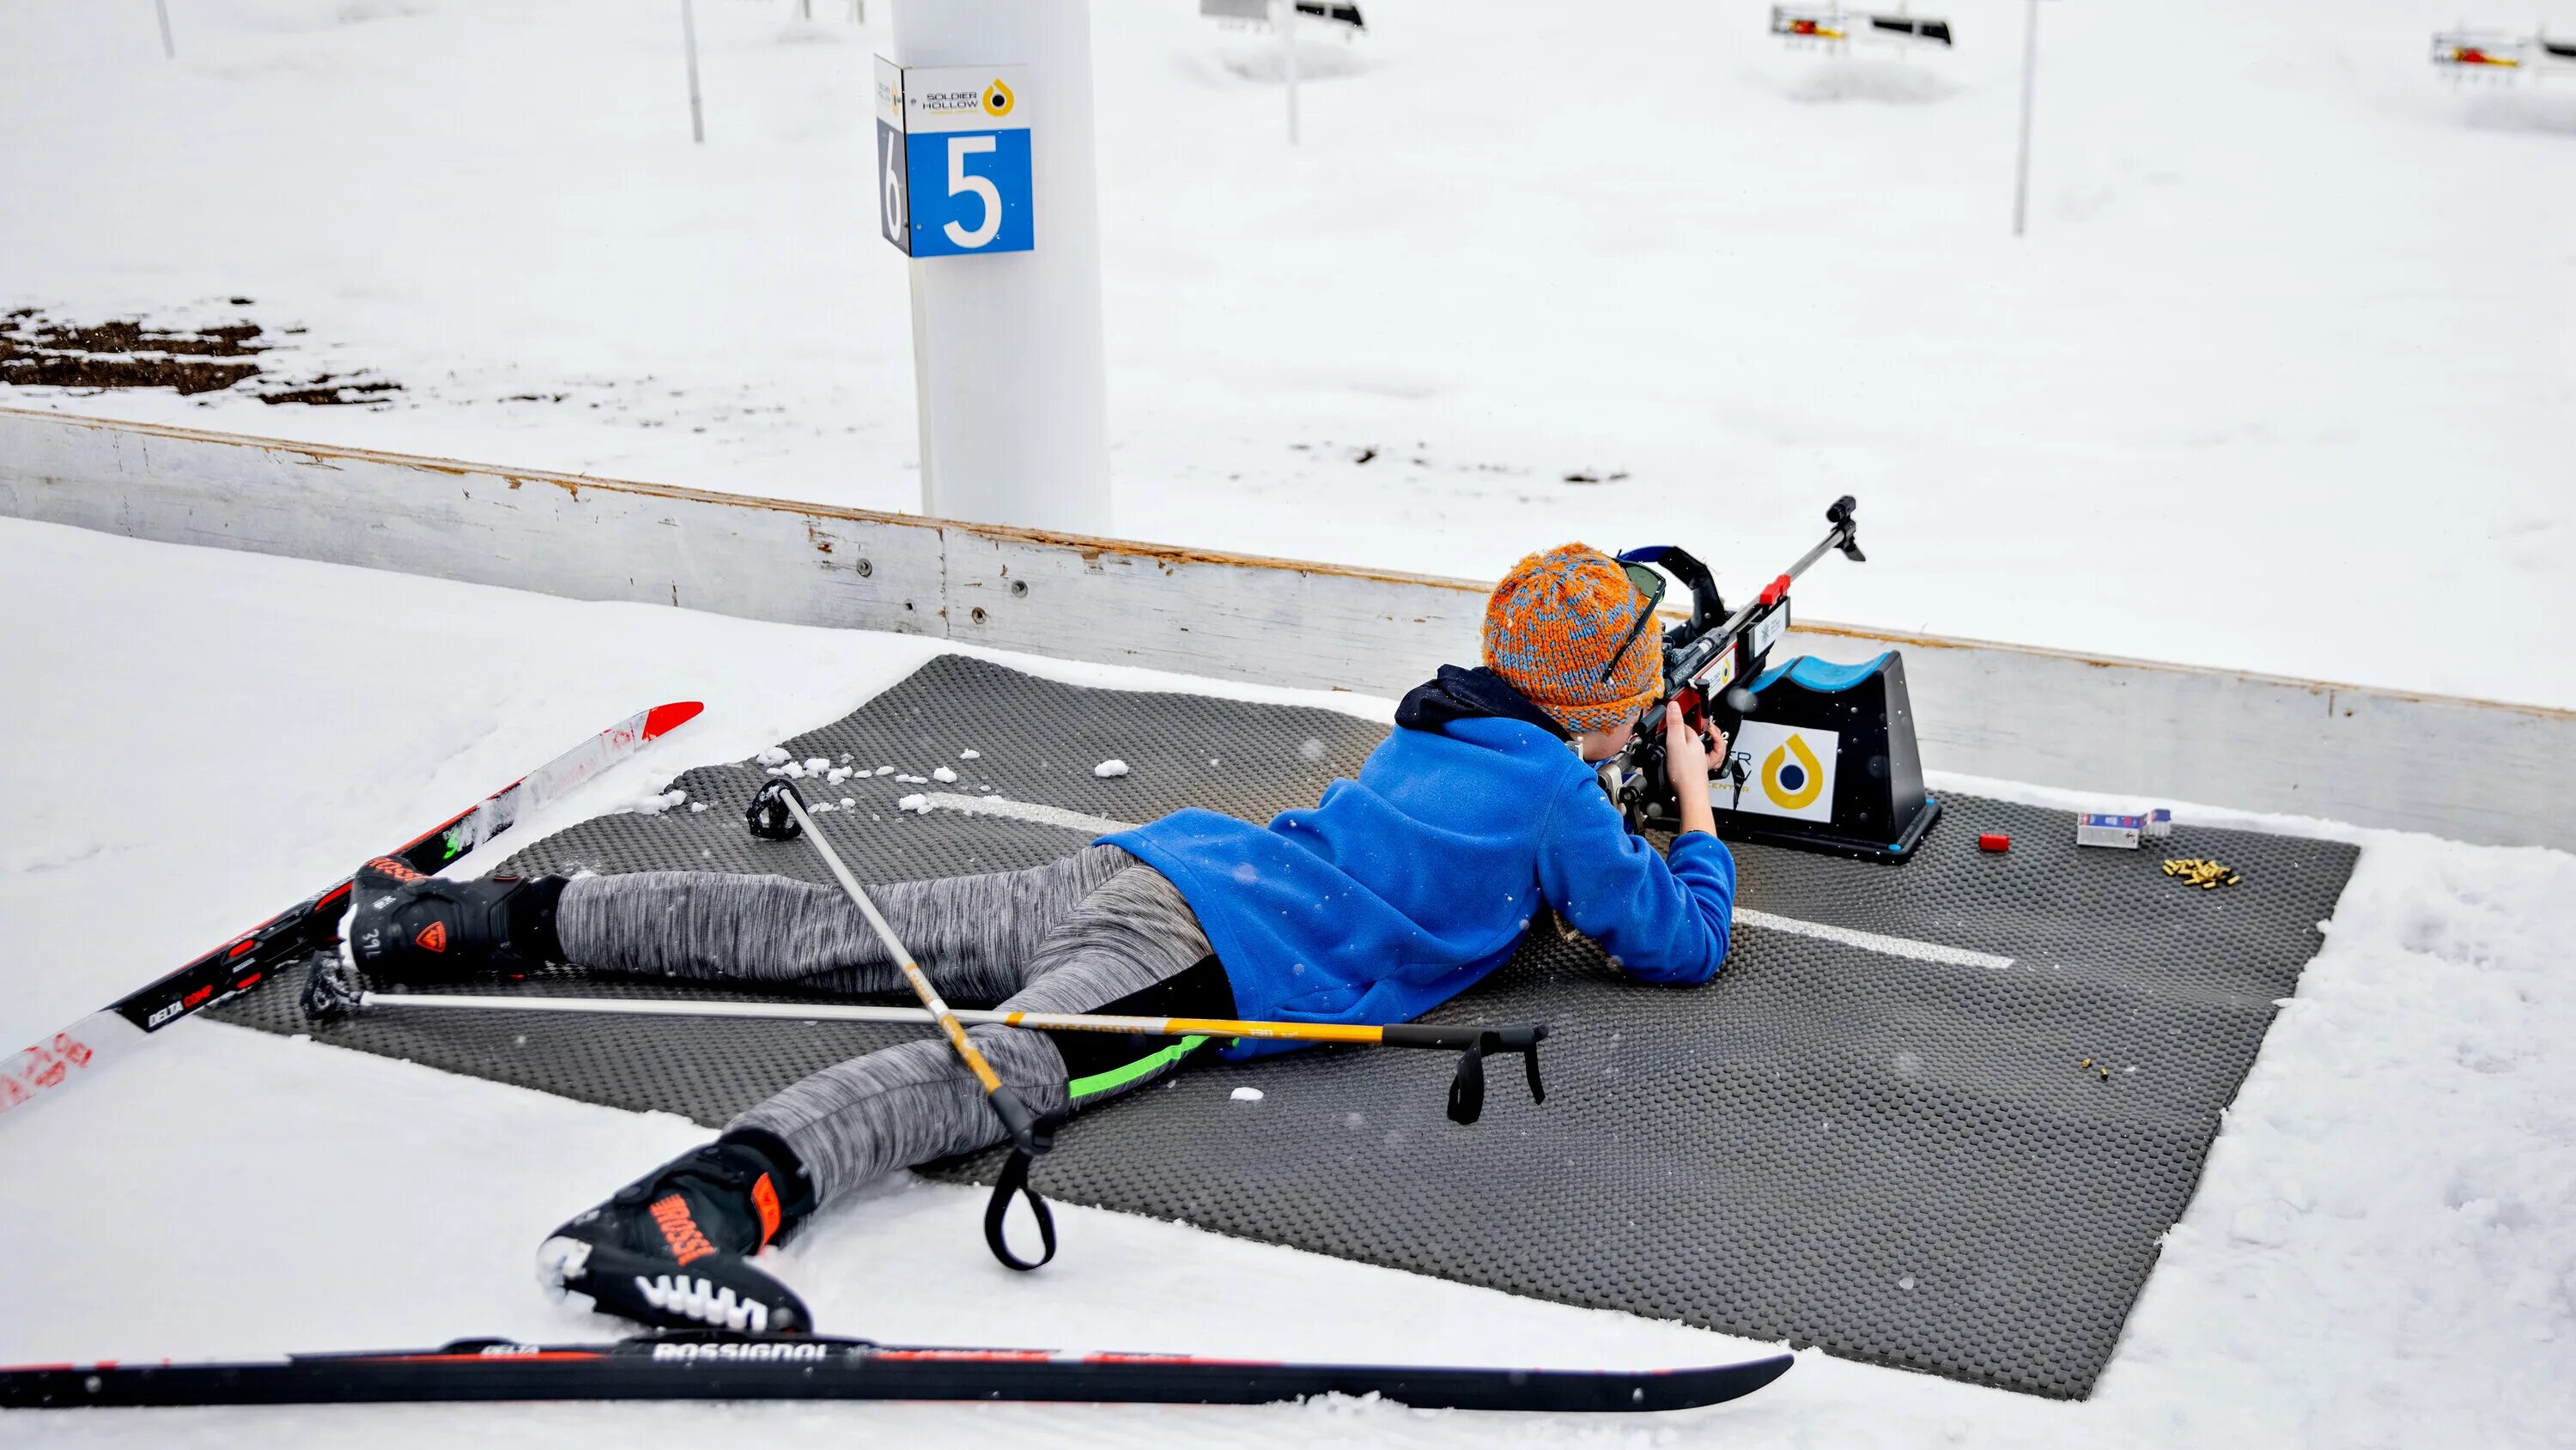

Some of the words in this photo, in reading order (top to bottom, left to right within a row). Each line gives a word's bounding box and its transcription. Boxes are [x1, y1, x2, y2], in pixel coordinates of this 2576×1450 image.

[922, 100, 978, 110] HOLLOW
[927, 91, 977, 100] SOLDIER
[885, 130, 901, 242] 6
[943, 135, 1002, 248] 5
[148, 1000, 185, 1028] DELTA
[183, 985, 214, 1008] COMP
[653, 1343, 828, 1362] ROSSIGNOL
